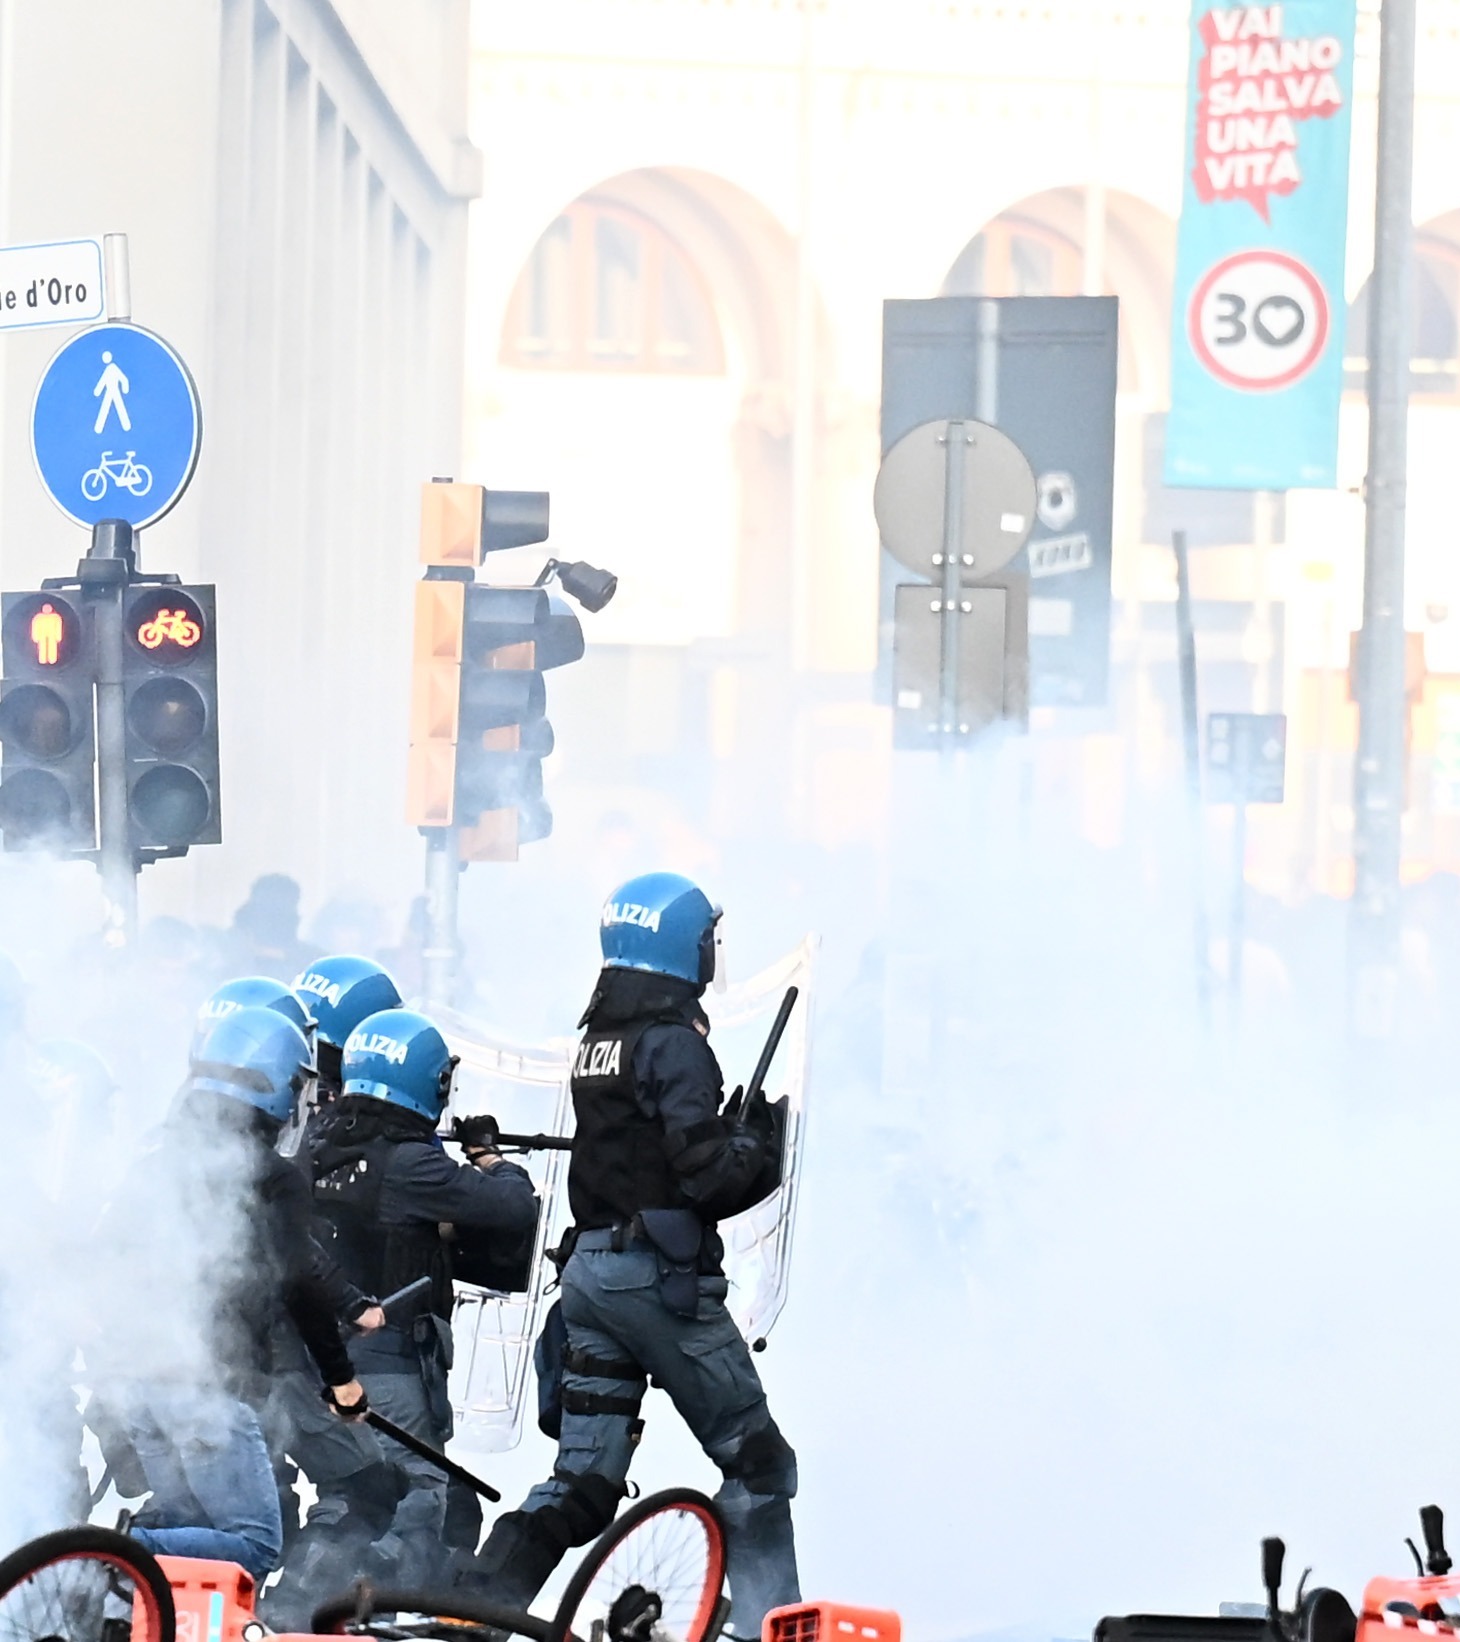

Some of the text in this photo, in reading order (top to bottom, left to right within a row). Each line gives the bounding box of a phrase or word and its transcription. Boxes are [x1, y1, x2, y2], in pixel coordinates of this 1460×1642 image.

[1211, 5, 1282, 41] VAI
[1209, 36, 1342, 79] PIANO
[1207, 74, 1342, 116] SALVA
[1206, 114, 1297, 153] UNA
[1204, 150, 1300, 190] VITA
[0, 277, 87, 311] e d'Oro
